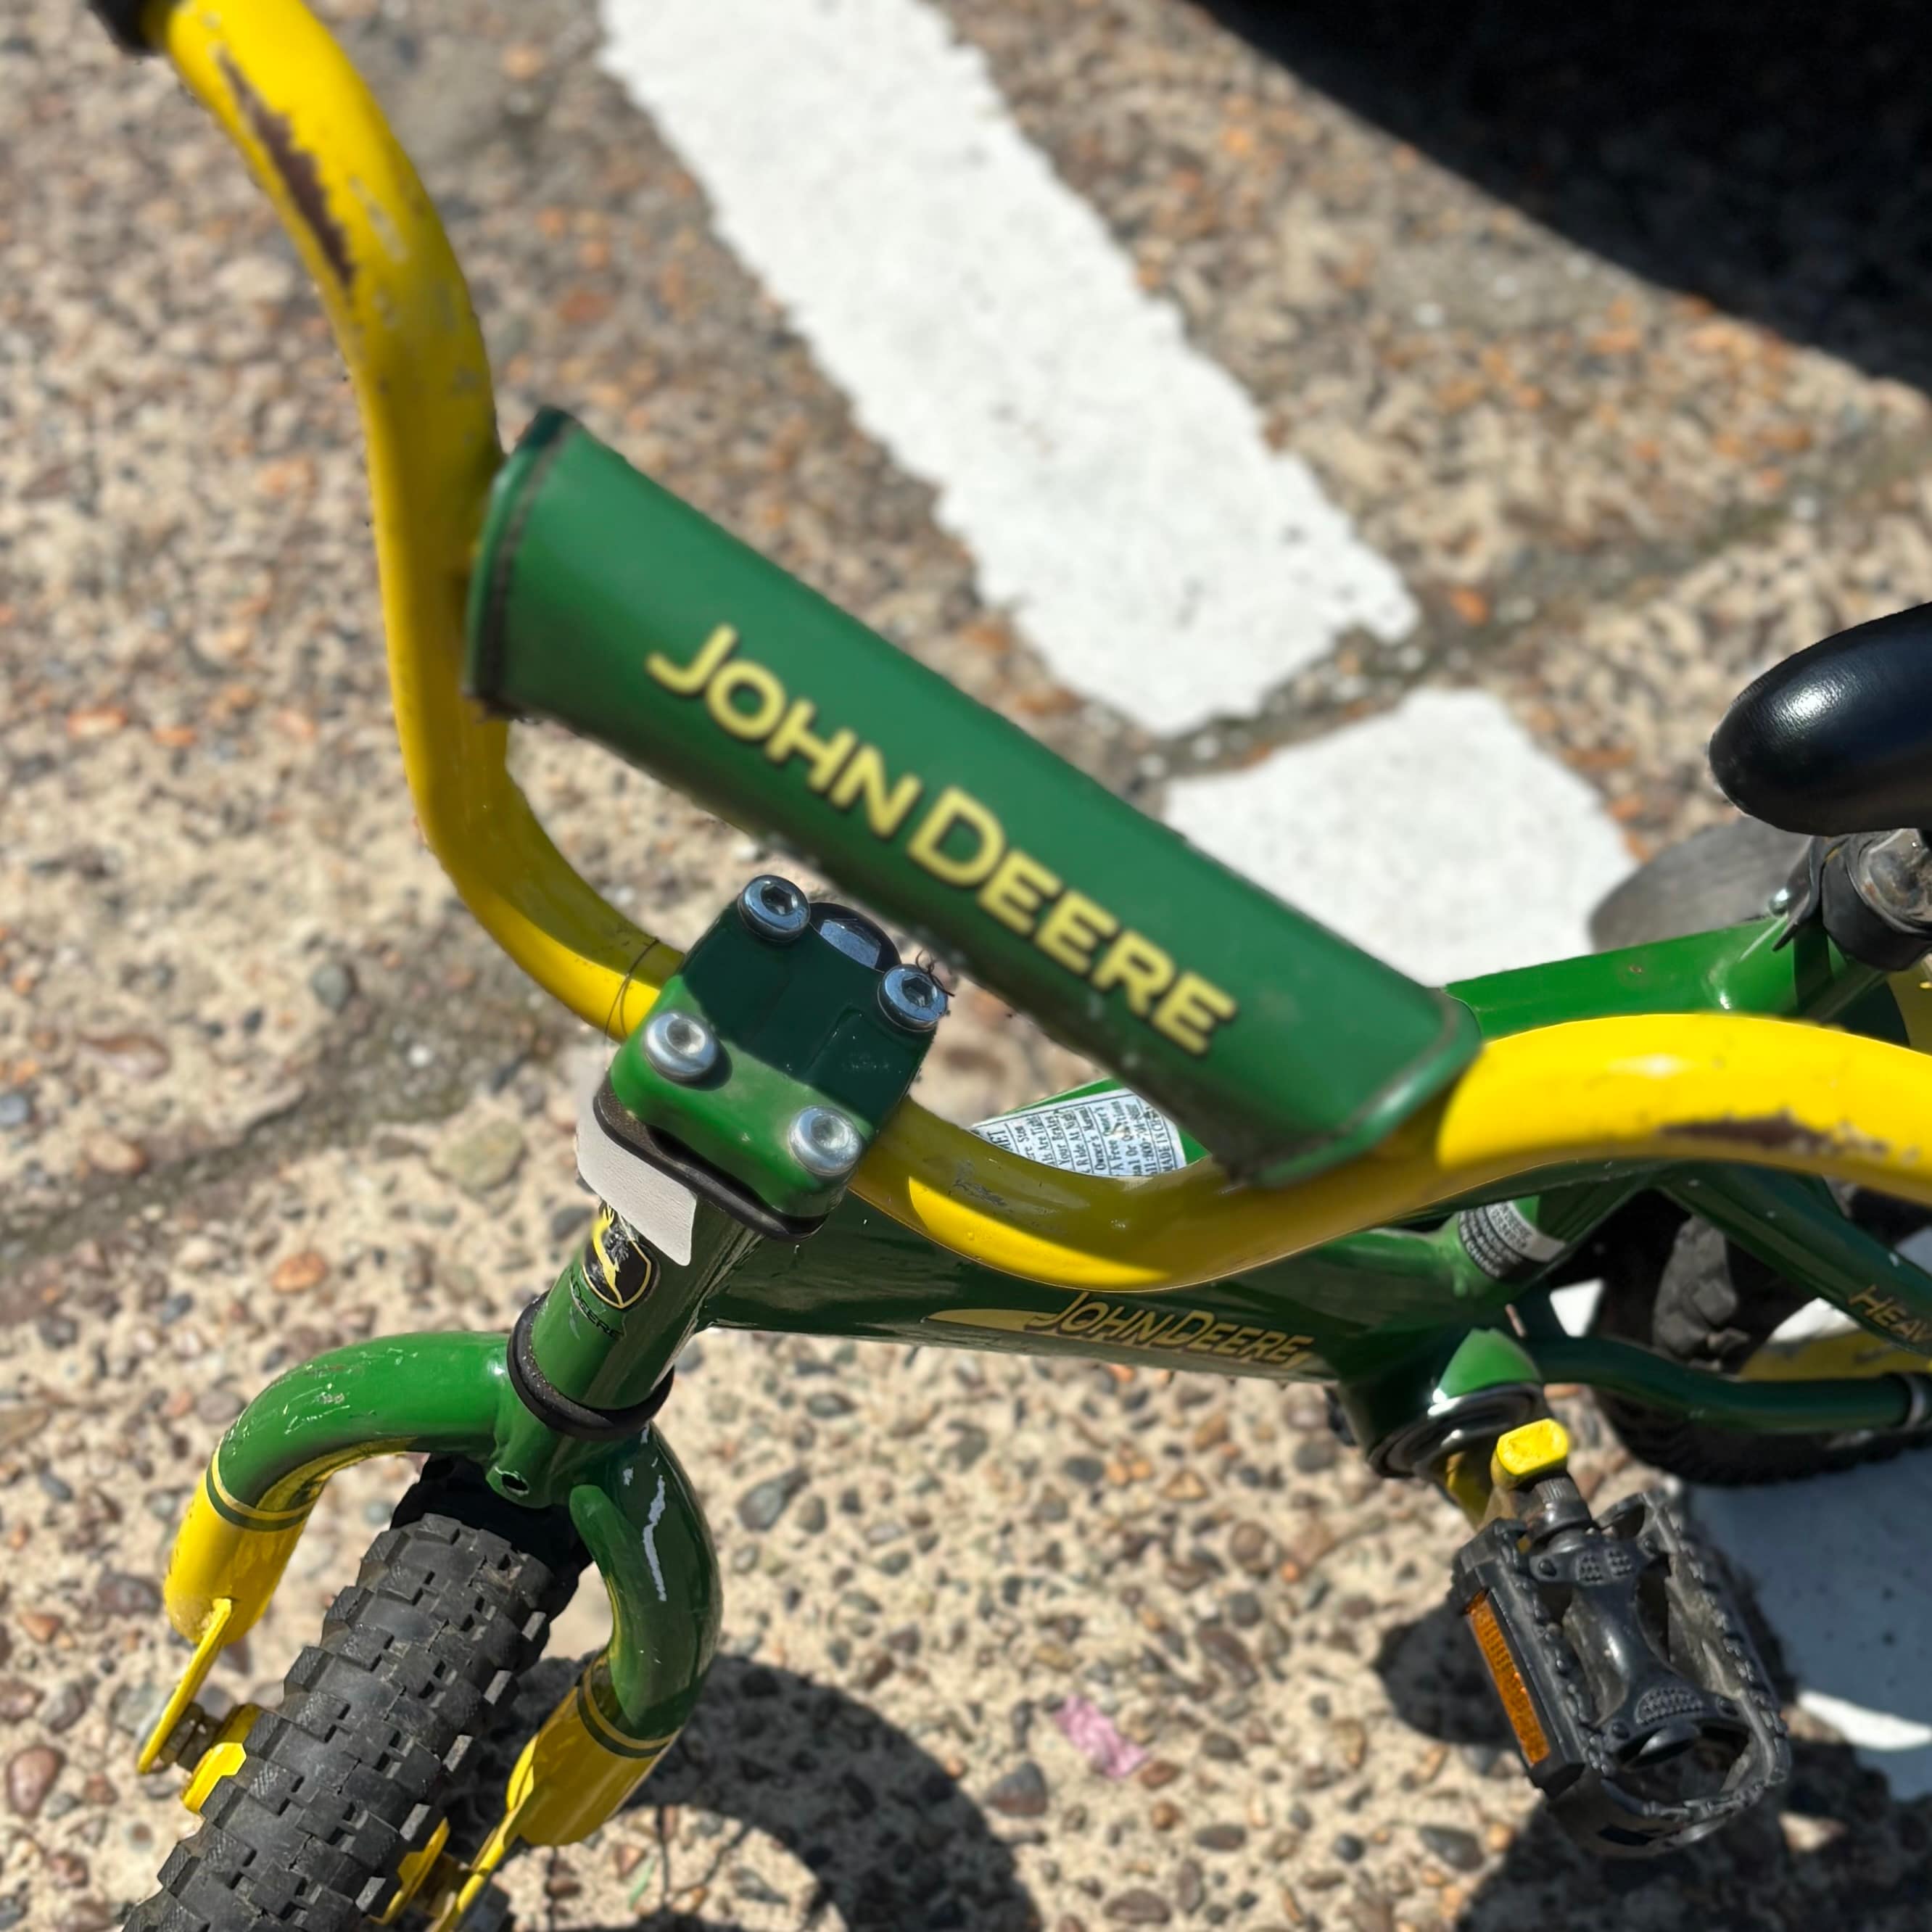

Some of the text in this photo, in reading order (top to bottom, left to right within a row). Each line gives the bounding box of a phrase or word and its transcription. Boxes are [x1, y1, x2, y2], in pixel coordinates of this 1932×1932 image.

[645, 623, 1239, 1057] JOHN DEERE
[1034, 1136, 1049, 1150] Are
[1067, 1131, 1081, 1142] At
[1052, 1143, 1071, 1165] Your
[1070, 1143, 1089, 1166] Ride
[1027, 1292, 1314, 1363] JOHN DEERE
